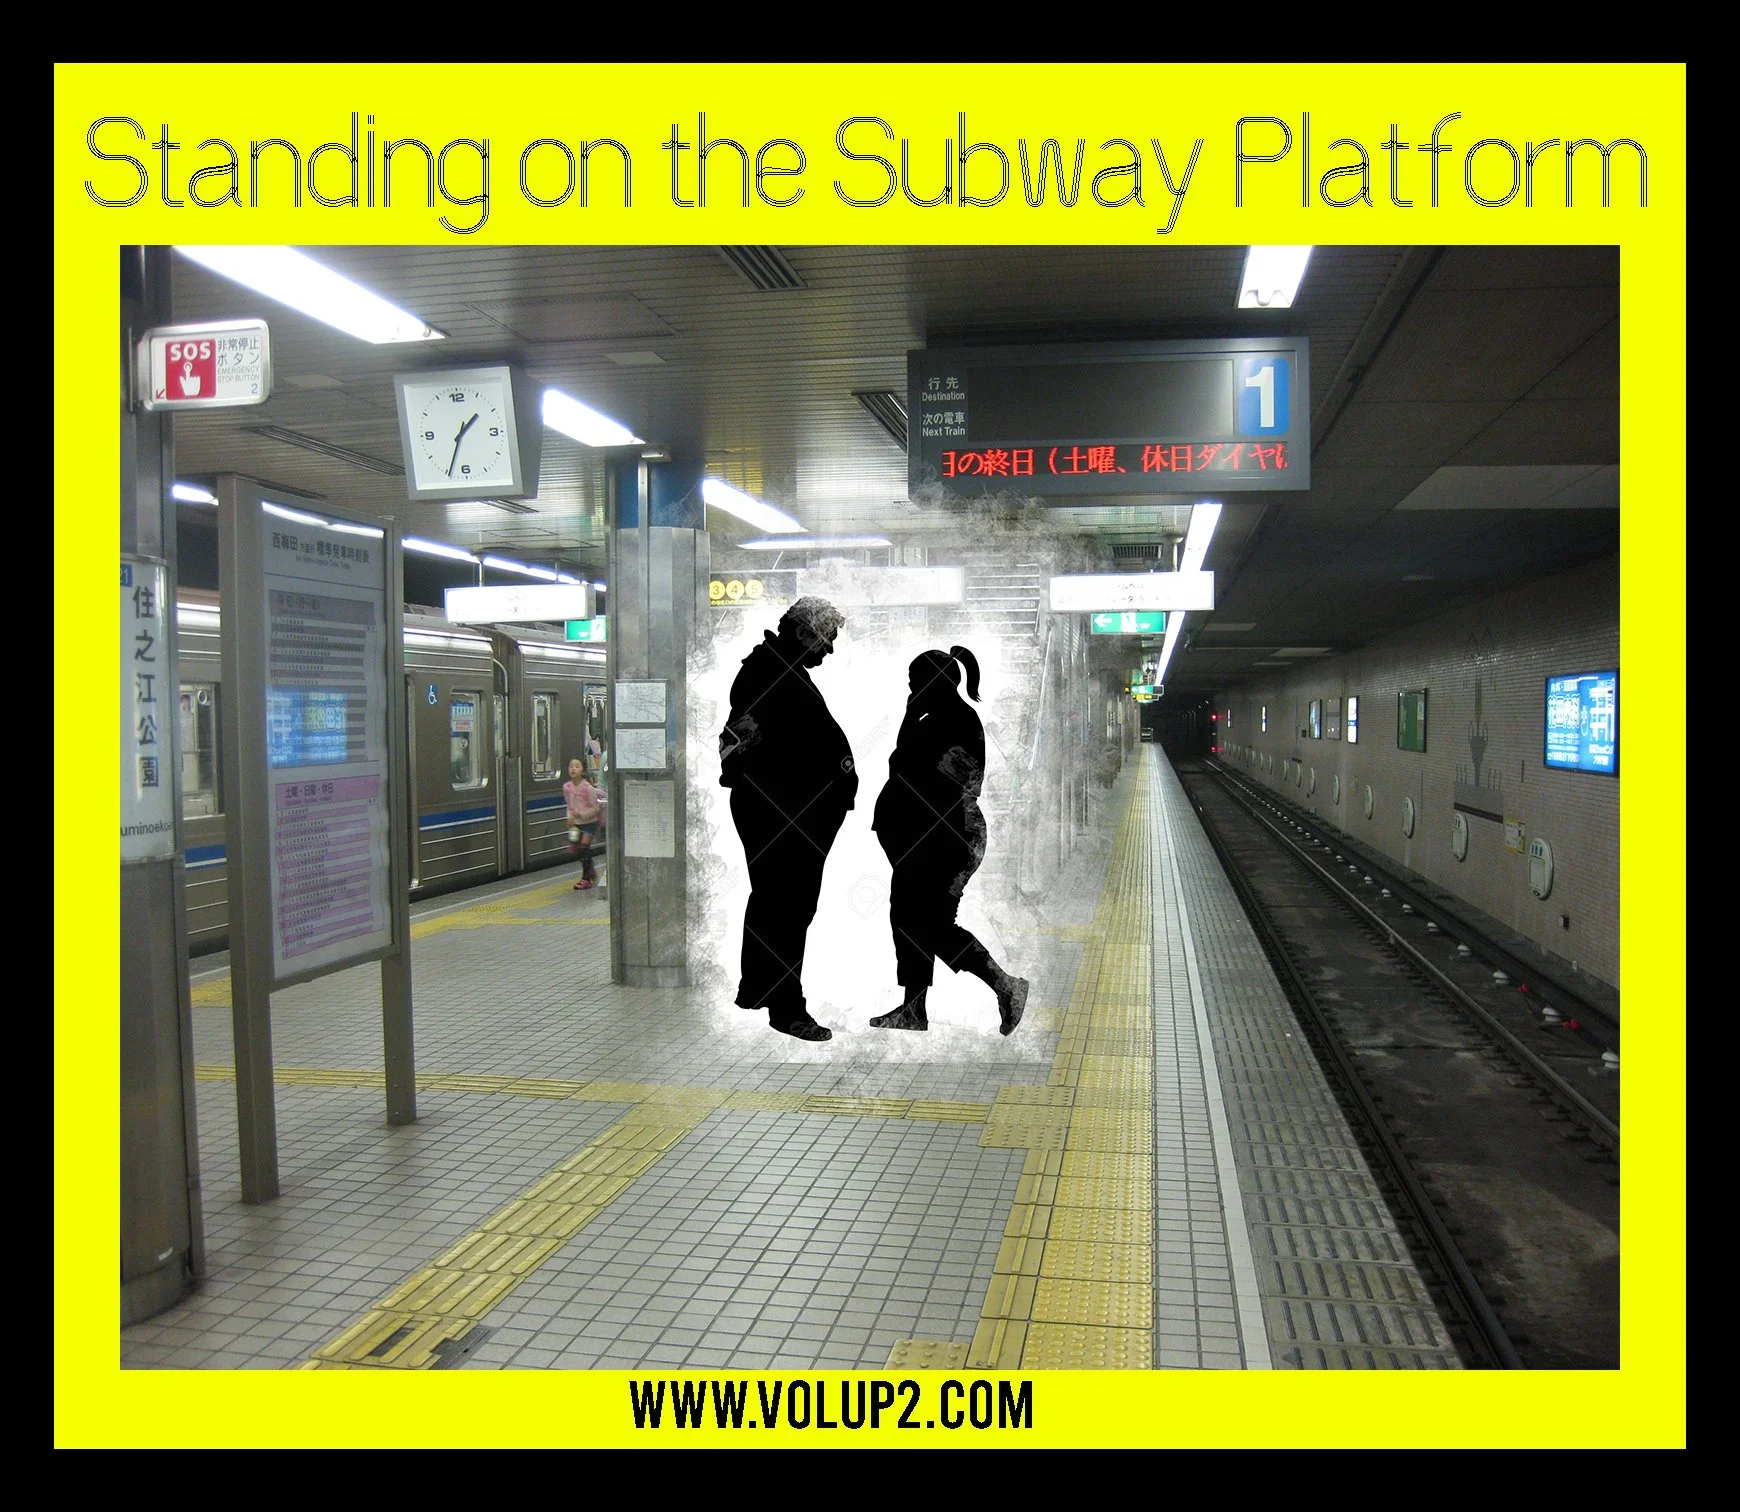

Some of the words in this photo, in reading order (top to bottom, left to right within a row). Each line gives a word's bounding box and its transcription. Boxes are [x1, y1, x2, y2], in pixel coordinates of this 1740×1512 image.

[217, 336, 260, 351] 非常停止
[170, 342, 211, 362] SOS
[217, 352, 260, 366] ボタン
[217, 365, 260, 376] EMERGENCY
[217, 375, 235, 383] STOP
[235, 374, 260, 382] BUTTON
[251, 383, 258, 395] 2
[449, 392, 465, 403] 12
[922, 391, 965, 402] Destination
[1245, 366, 1275, 428] 1
[922, 411, 965, 425] 次の電車
[424, 431, 435, 441] 9
[489, 427, 499, 437] 3
[922, 427, 943, 437] Next
[944, 426, 966, 436] Train
[461, 464, 471, 474] 6
[133, 585, 159, 788] 住之江公園
